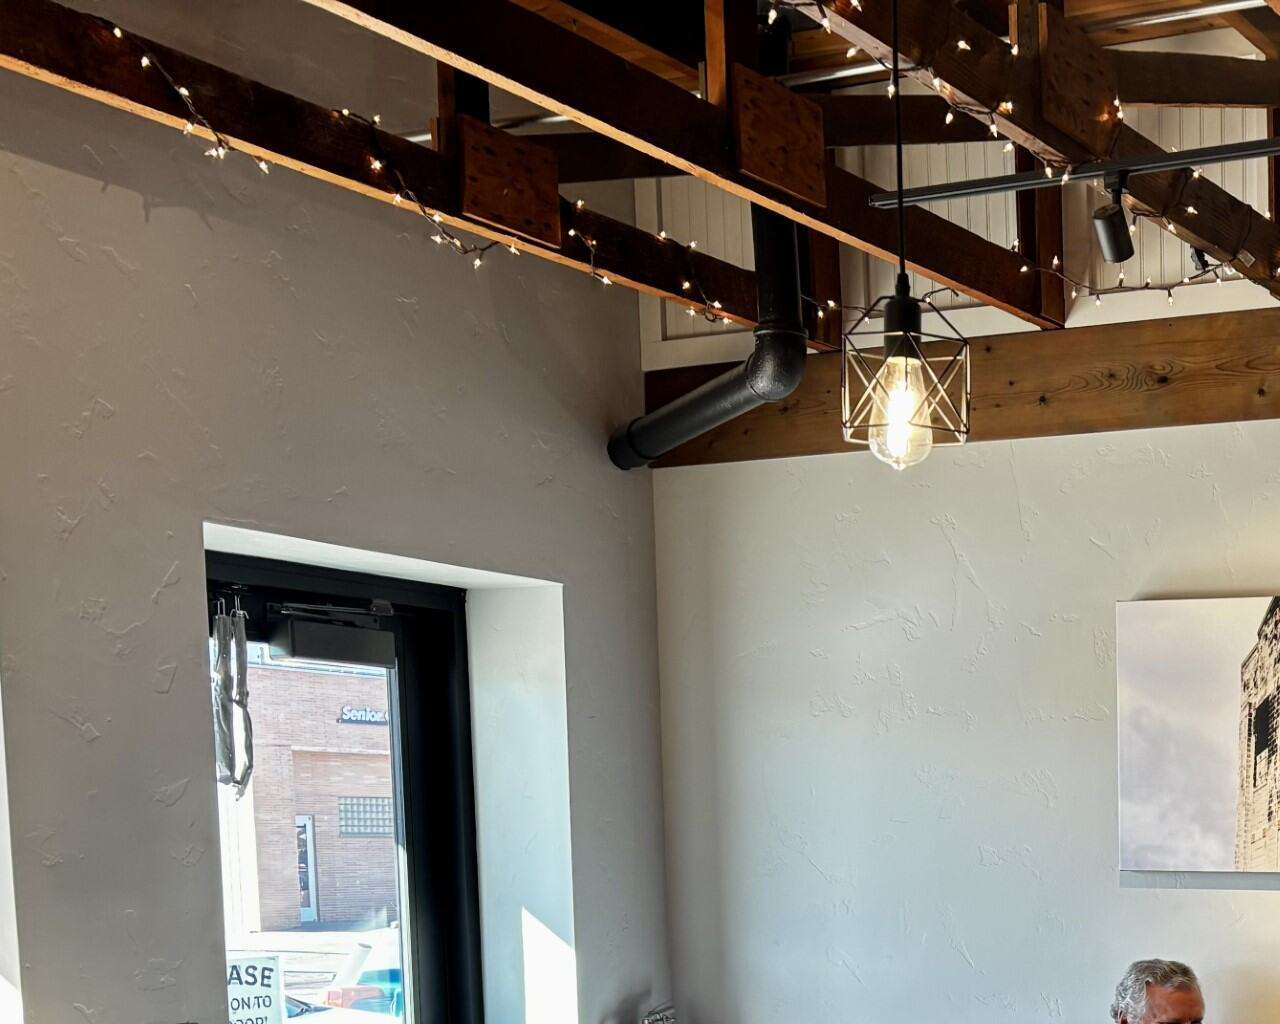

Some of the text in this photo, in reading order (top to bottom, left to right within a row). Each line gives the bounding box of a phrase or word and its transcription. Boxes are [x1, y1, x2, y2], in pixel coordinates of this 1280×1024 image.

[342, 703, 384, 722] Senior
[230, 995, 272, 1011] ON TO
